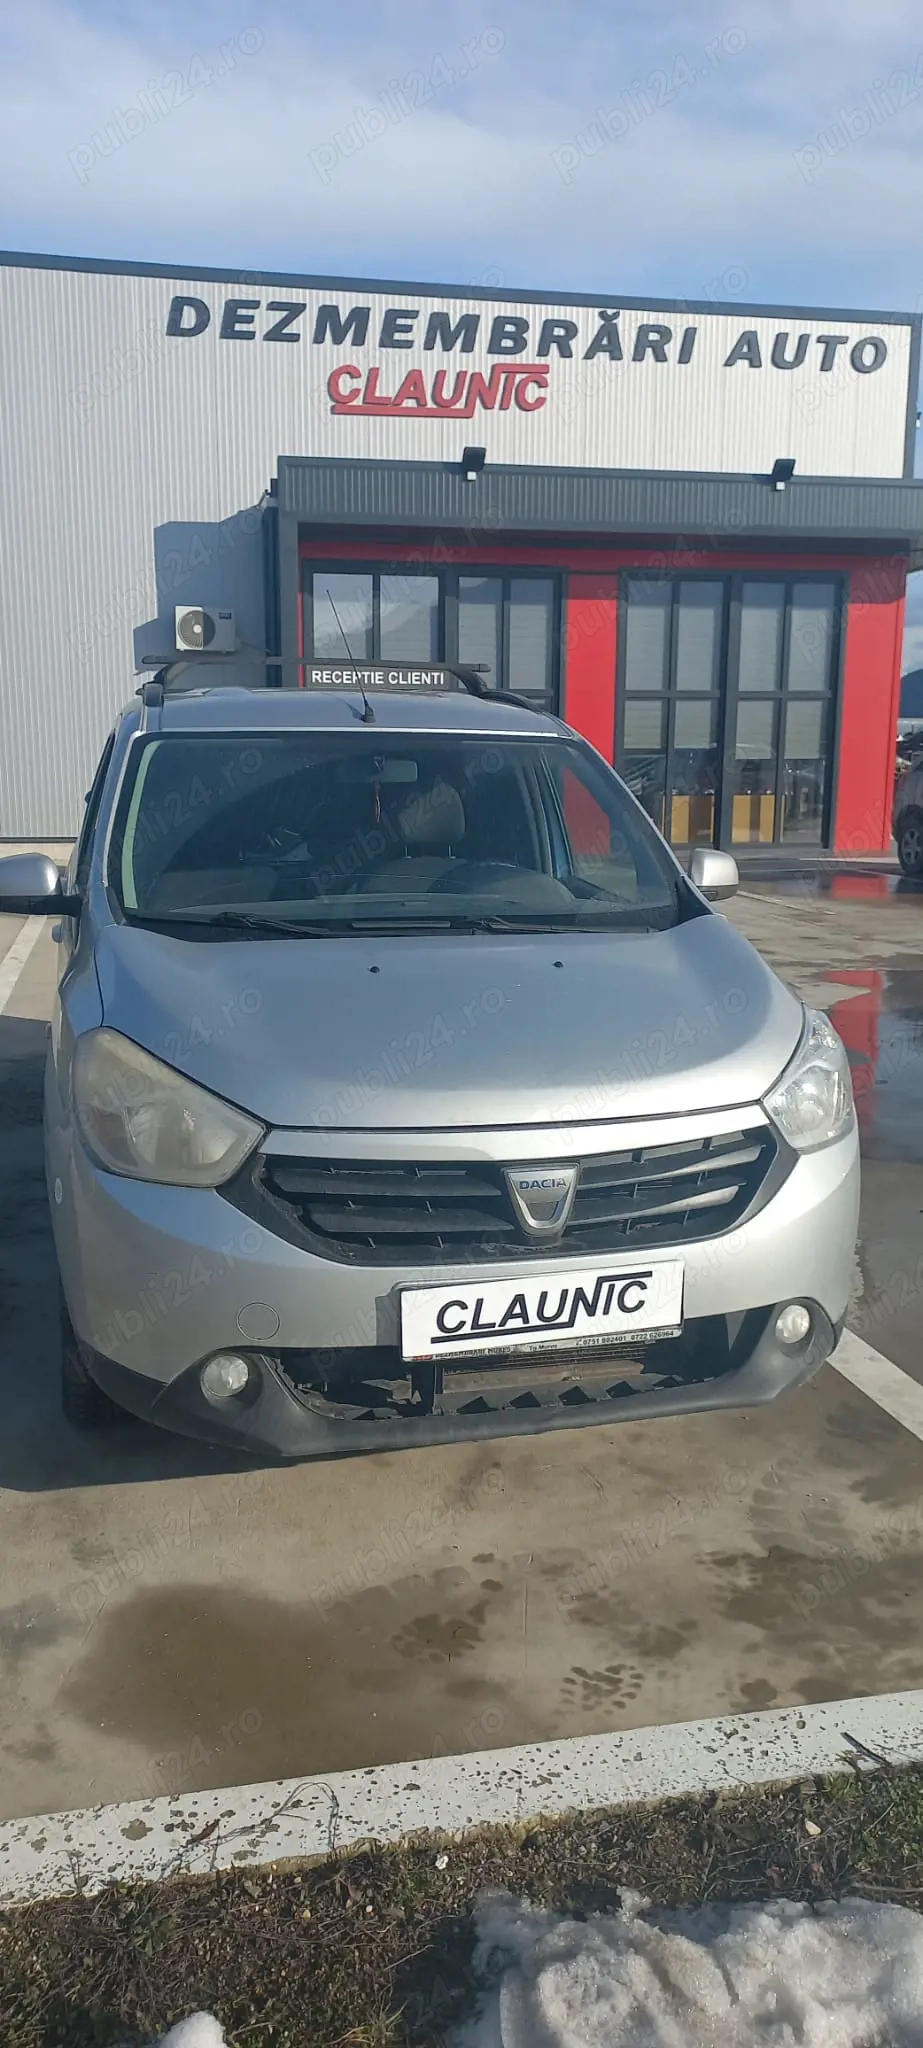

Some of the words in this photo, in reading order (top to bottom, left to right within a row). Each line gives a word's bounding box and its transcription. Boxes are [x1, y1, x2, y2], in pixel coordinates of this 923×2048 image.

[165, 295, 698, 365] DEZMEMBRĂRI
[723, 329, 889, 375] AUTO
[327, 363, 550, 419] CLAUNIC
[388, 671, 444, 686] CLIENTI
[519, 1178, 567, 1190] DACIA
[430, 1270, 653, 1345] CLAUNIC
